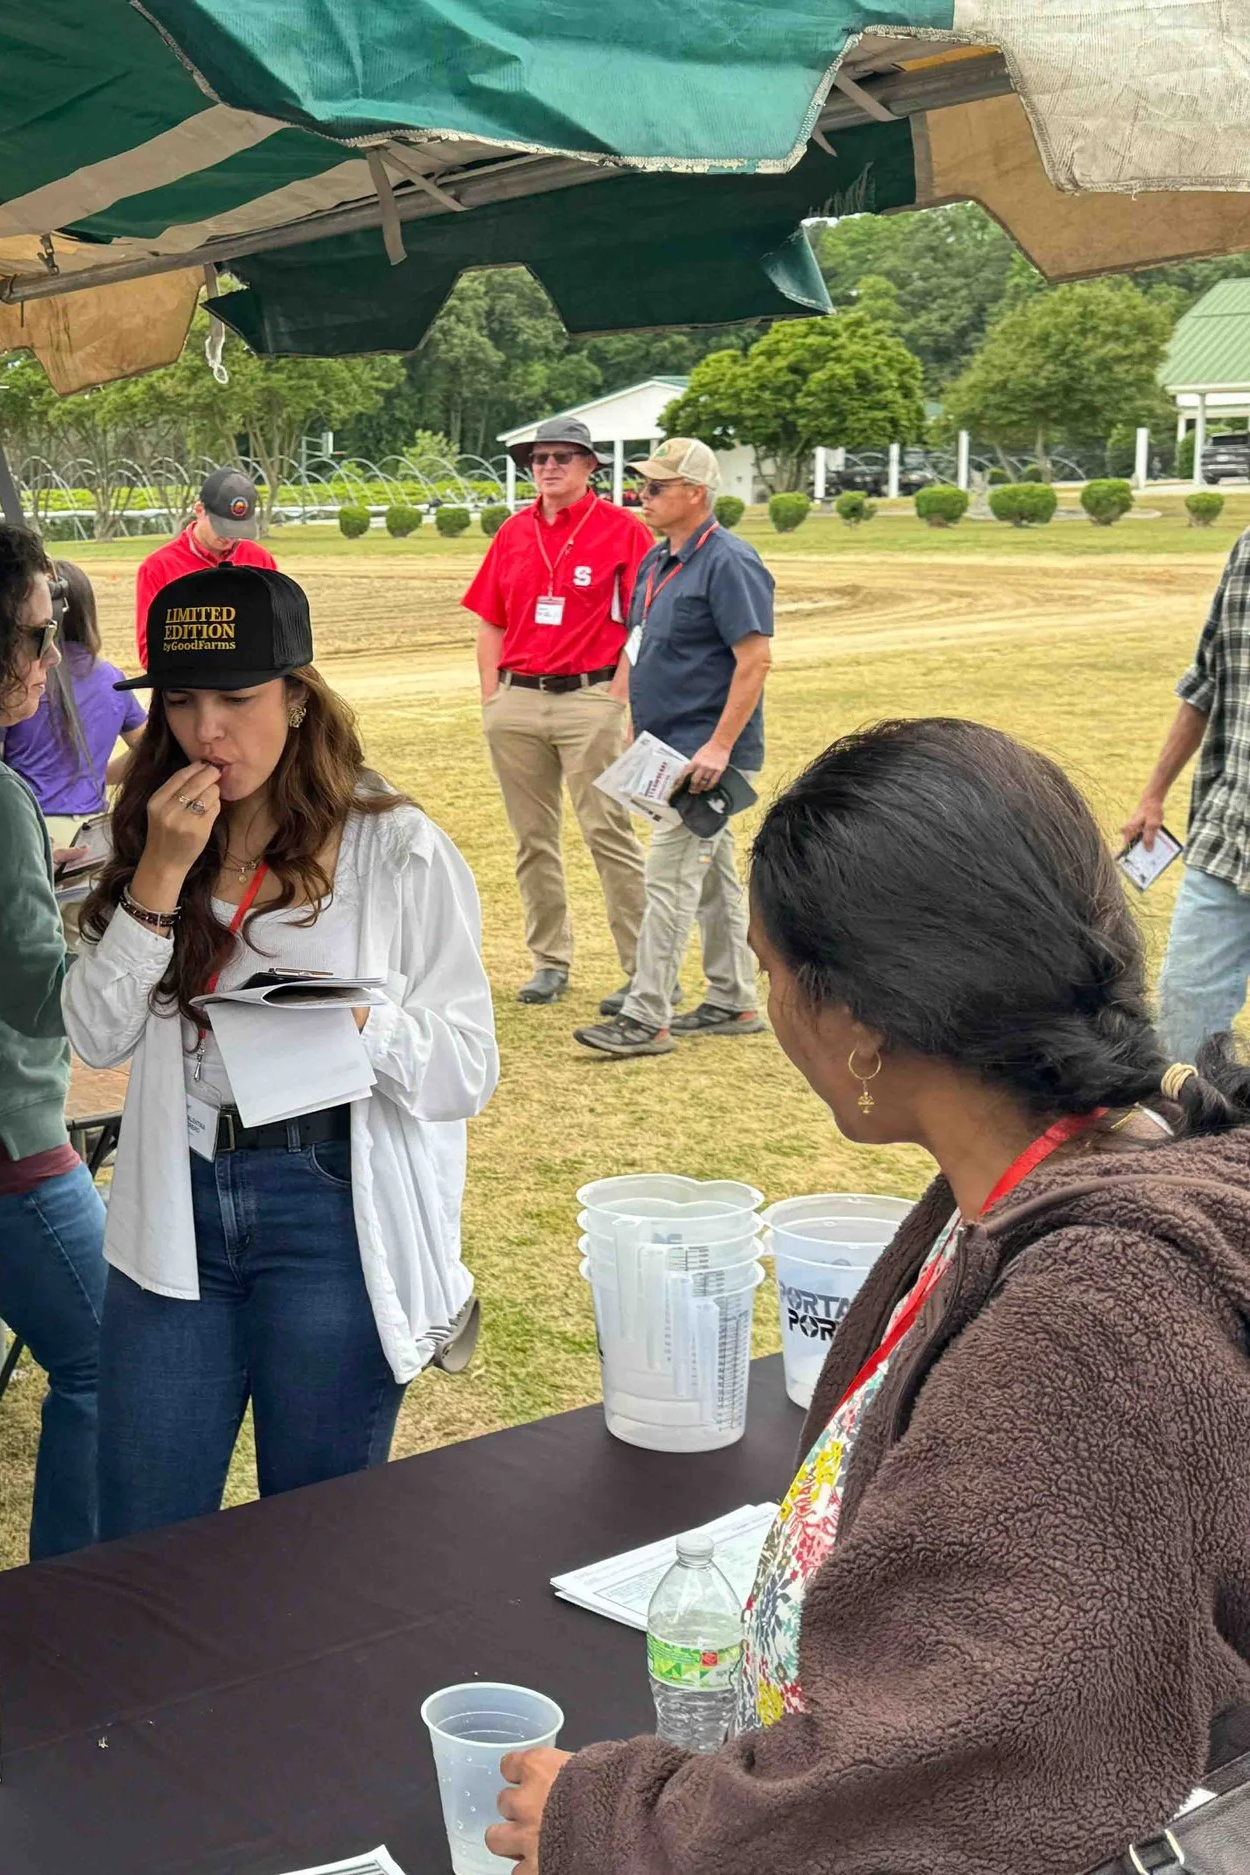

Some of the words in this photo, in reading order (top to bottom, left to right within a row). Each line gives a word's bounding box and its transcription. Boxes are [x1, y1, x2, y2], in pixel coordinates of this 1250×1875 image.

[573, 565, 592, 588] S
[165, 606, 236, 623] LIMITED
[164, 623, 236, 641] EDITION
